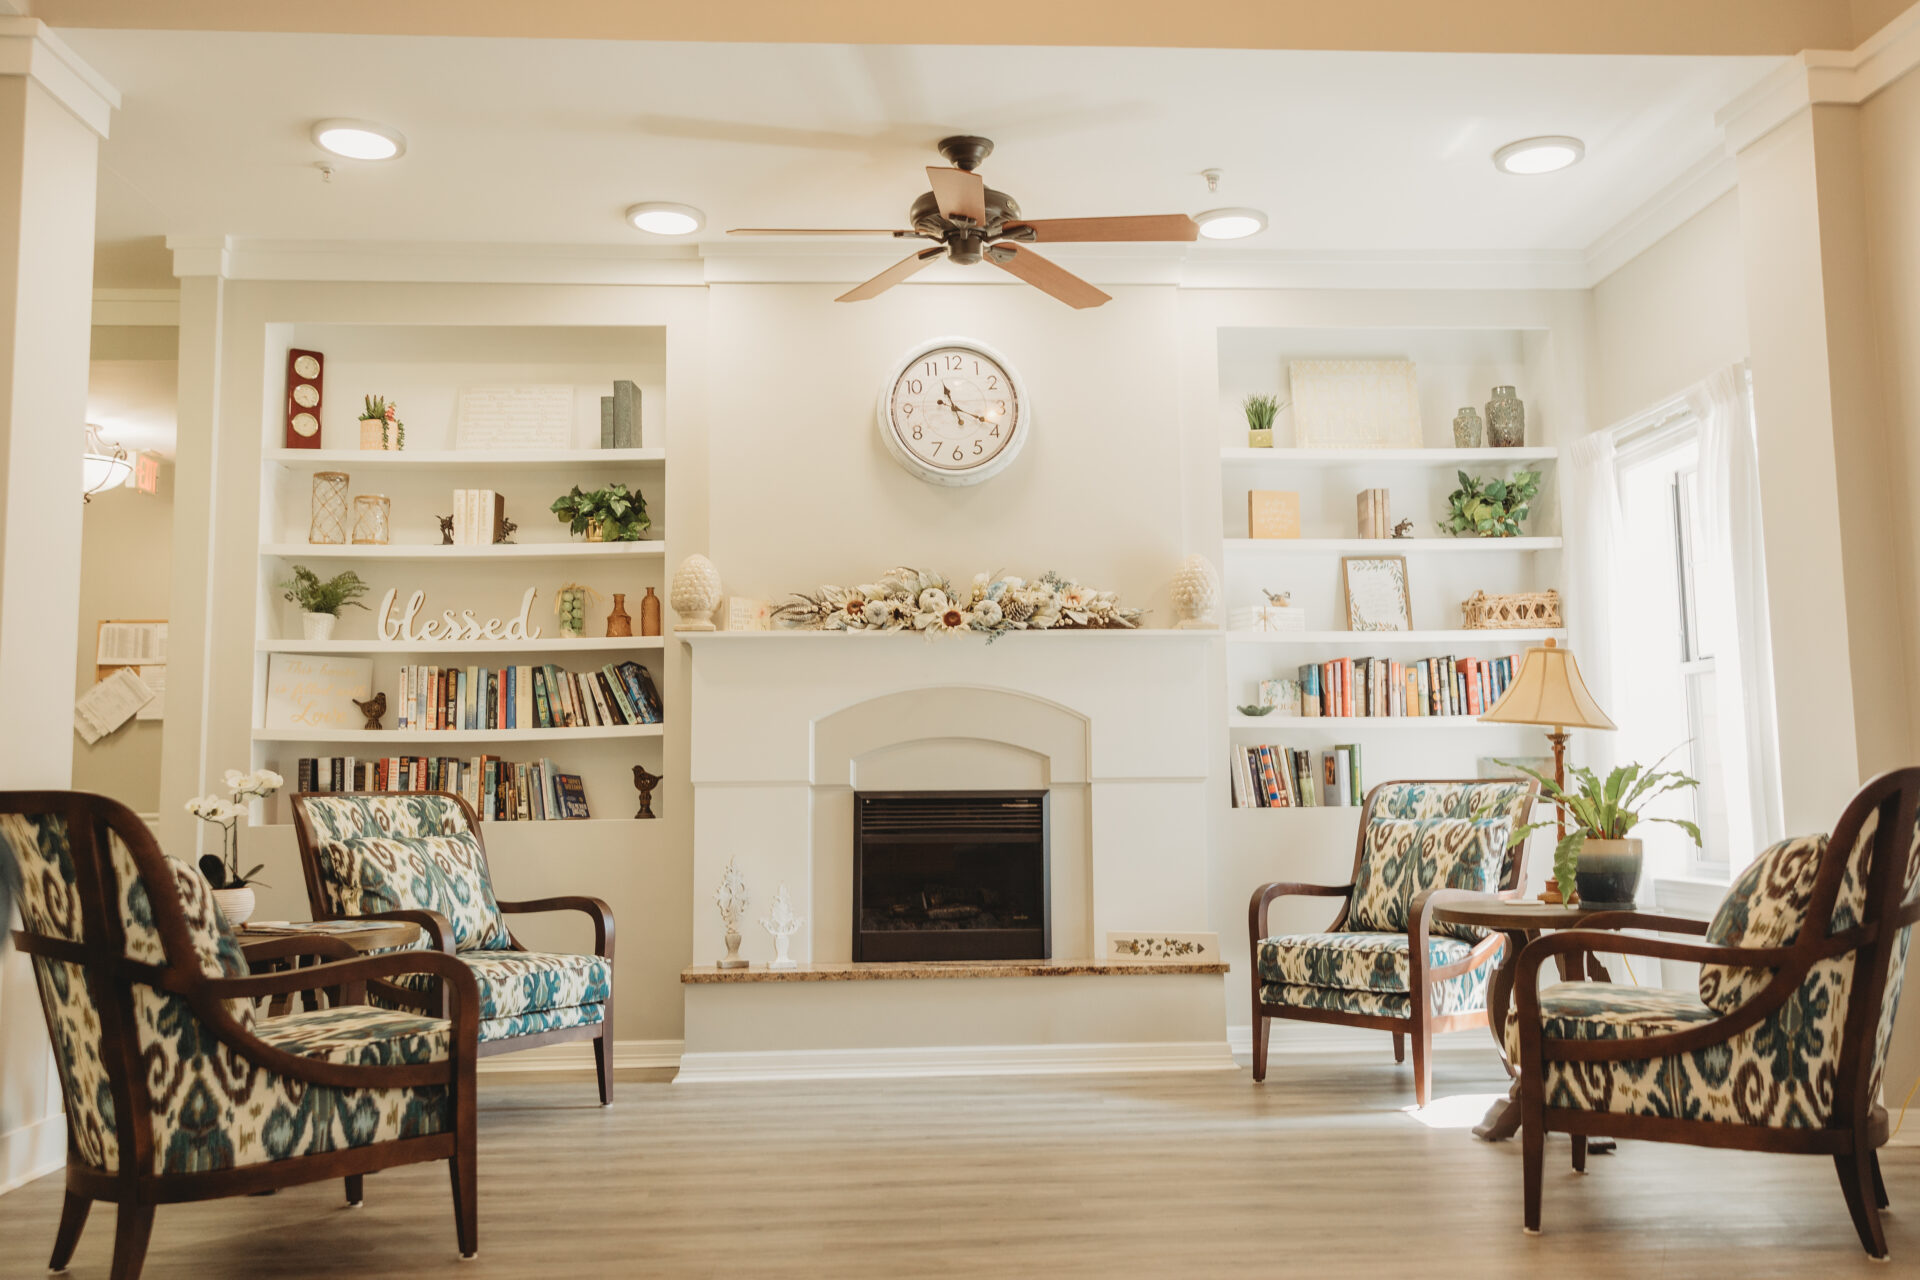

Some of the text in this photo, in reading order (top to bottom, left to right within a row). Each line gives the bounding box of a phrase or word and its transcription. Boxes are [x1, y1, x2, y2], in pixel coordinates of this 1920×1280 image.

[925, 362, 937, 377] 11
[945, 355, 962, 371] 12
[973, 361, 979, 375] 1
[906, 379, 922, 395] 10
[987, 375, 998, 390] 2
[903, 403, 914, 419] 9
[996, 400, 1006, 415] 3
[912, 425, 923, 441] 8
[989, 424, 1000, 439] 4
[931, 442, 943, 457] 7
[952, 445, 964, 461] 6
[972, 440, 983, 455] 5
[377, 586, 542, 641] blessed
